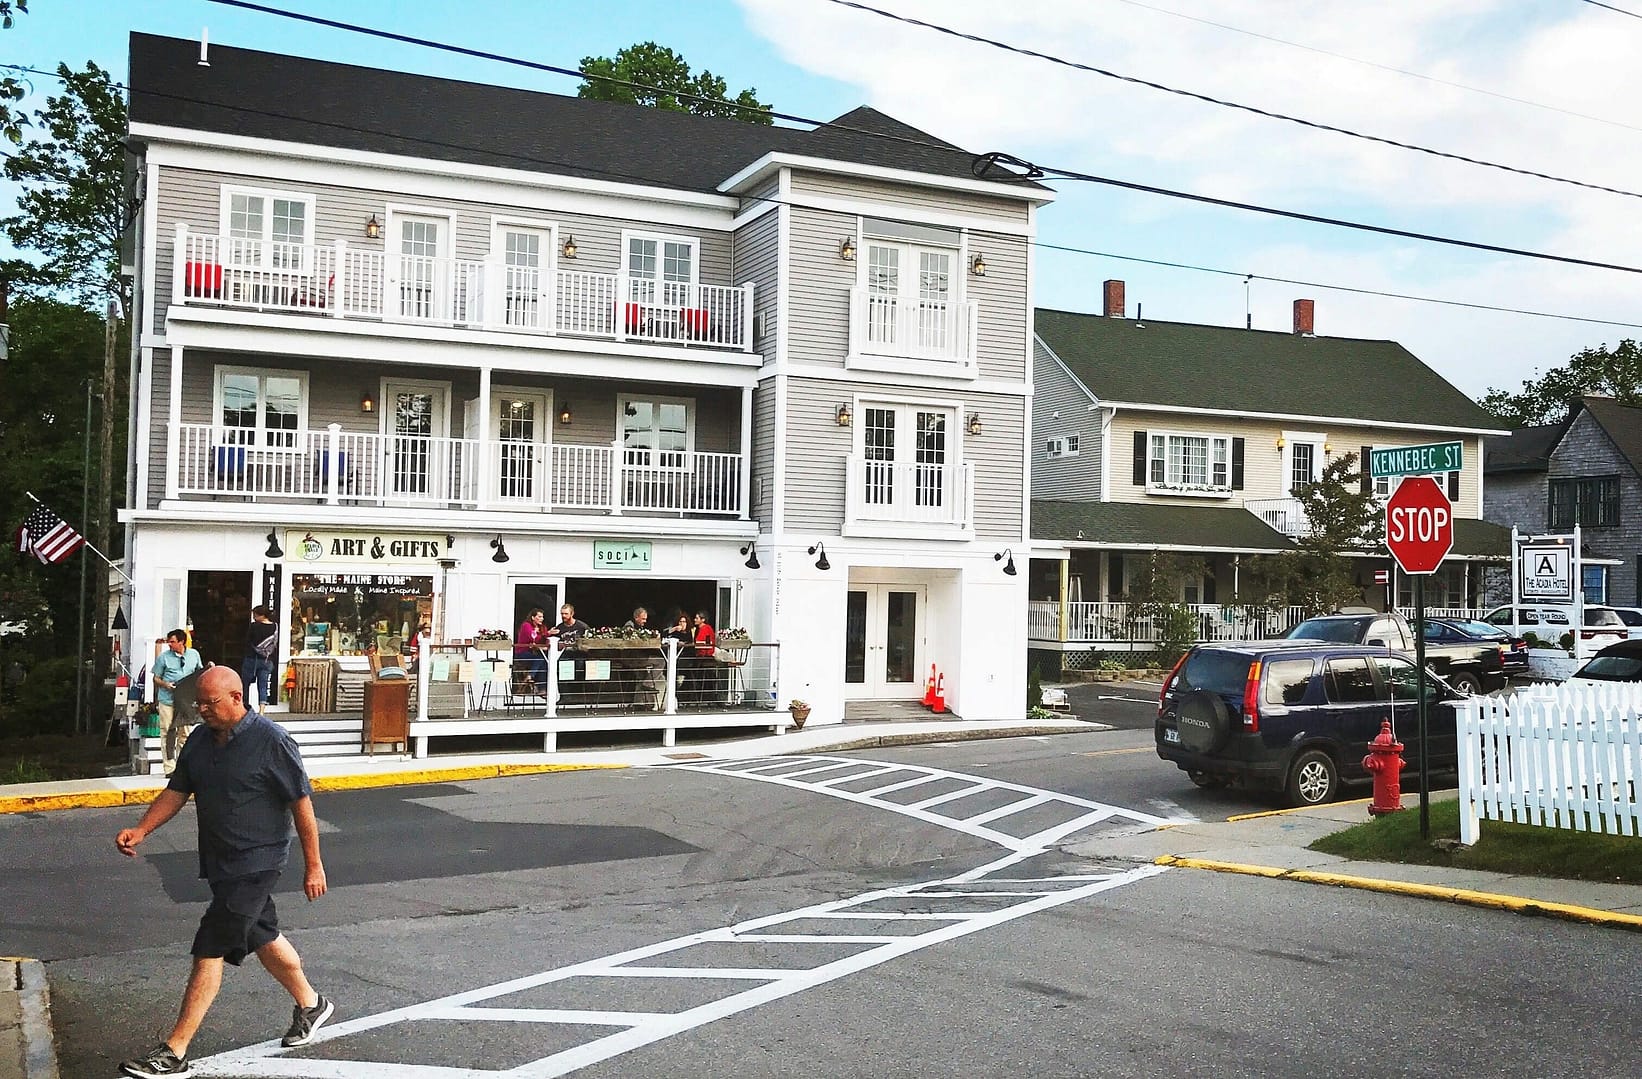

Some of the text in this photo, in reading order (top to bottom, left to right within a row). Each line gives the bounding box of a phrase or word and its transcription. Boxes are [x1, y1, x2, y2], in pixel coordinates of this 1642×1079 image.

[1373, 446, 1460, 474] KENNEBEC ST
[1391, 507, 1448, 542] STOP
[331, 536, 439, 560] ART & GIFTS
[1537, 556, 1555, 573] A
[343, 575, 372, 584] MAINE
[354, 585, 364, 595] &
[1181, 716, 1210, 728] HONDA
